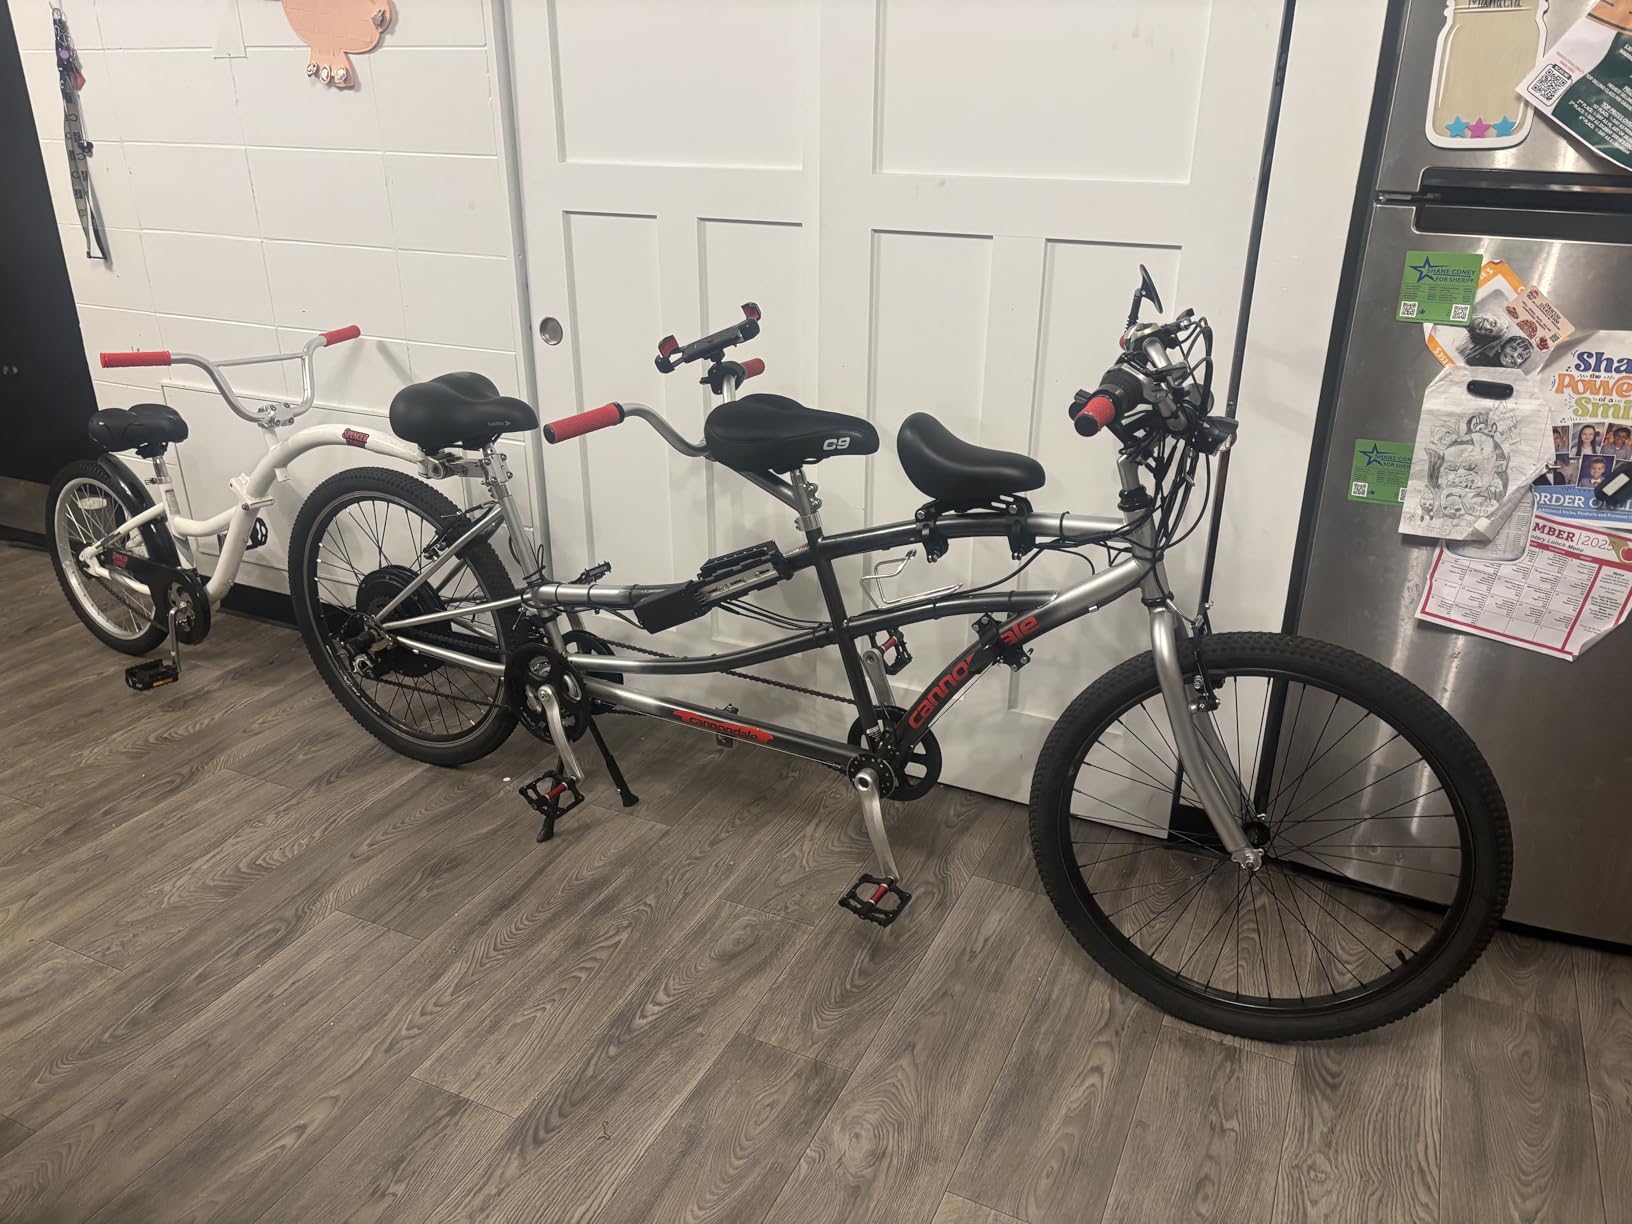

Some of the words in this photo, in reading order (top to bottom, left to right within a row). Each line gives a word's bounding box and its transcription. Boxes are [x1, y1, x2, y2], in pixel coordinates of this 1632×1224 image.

[1574, 351, 1632, 374] Sha
[1555, 373, 1632, 398] Powe
[1547, 538, 1566, 548] Lunch
[1567, 544, 1584, 552] Menu
[908, 616, 1040, 729] cannoale
